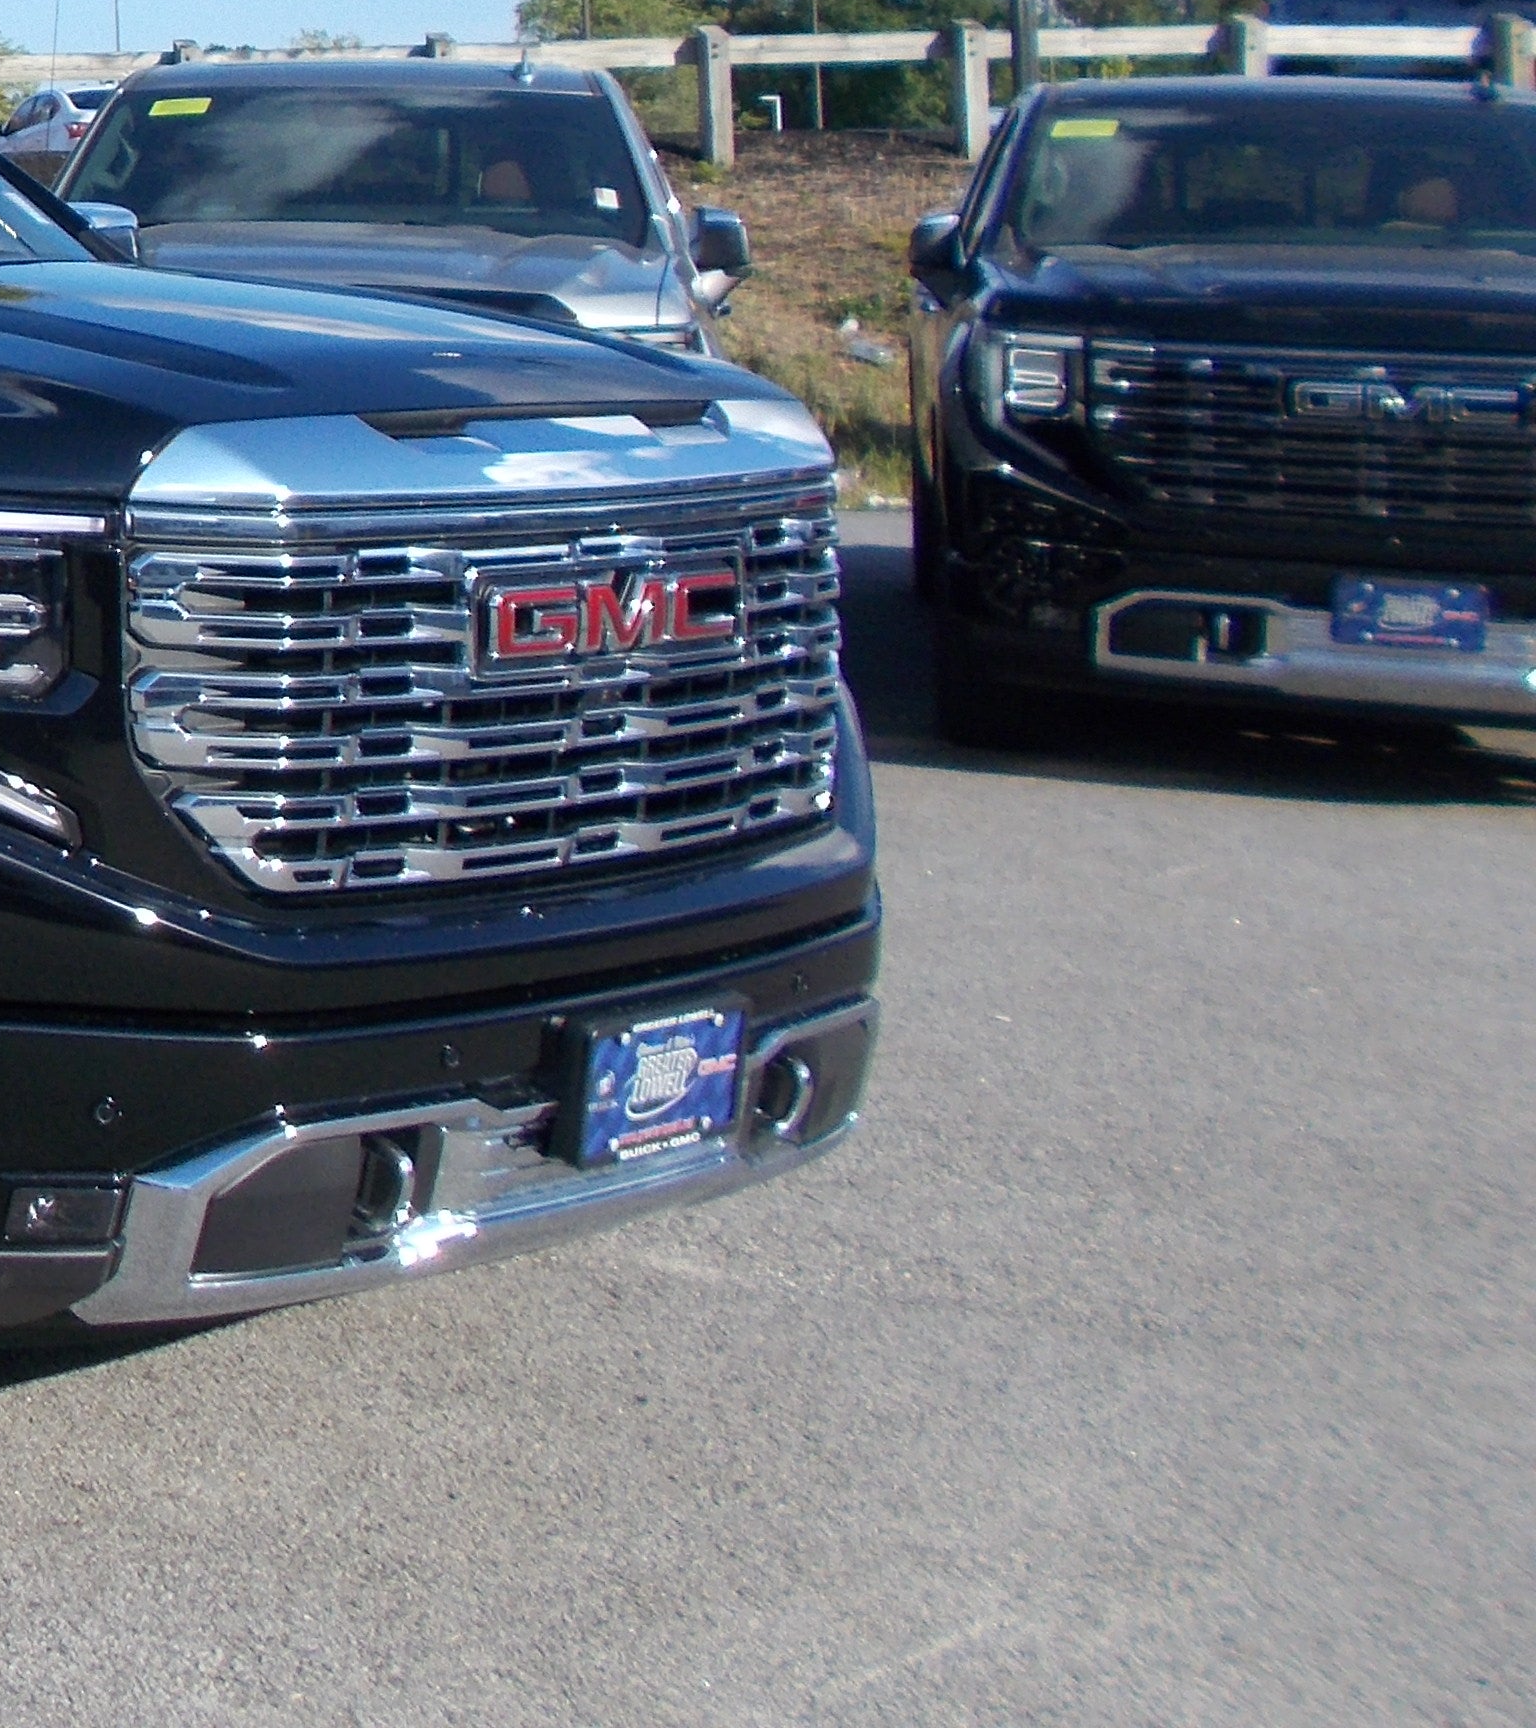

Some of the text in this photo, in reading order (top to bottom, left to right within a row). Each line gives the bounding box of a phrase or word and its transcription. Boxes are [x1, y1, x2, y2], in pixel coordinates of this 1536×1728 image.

[1294, 381, 1520, 423] GMC
[490, 571, 736, 660] GMC
[697, 1053, 737, 1076] GMC
[632, 1071, 688, 1104] LOWELL
[619, 1142, 662, 1161] BUICK
